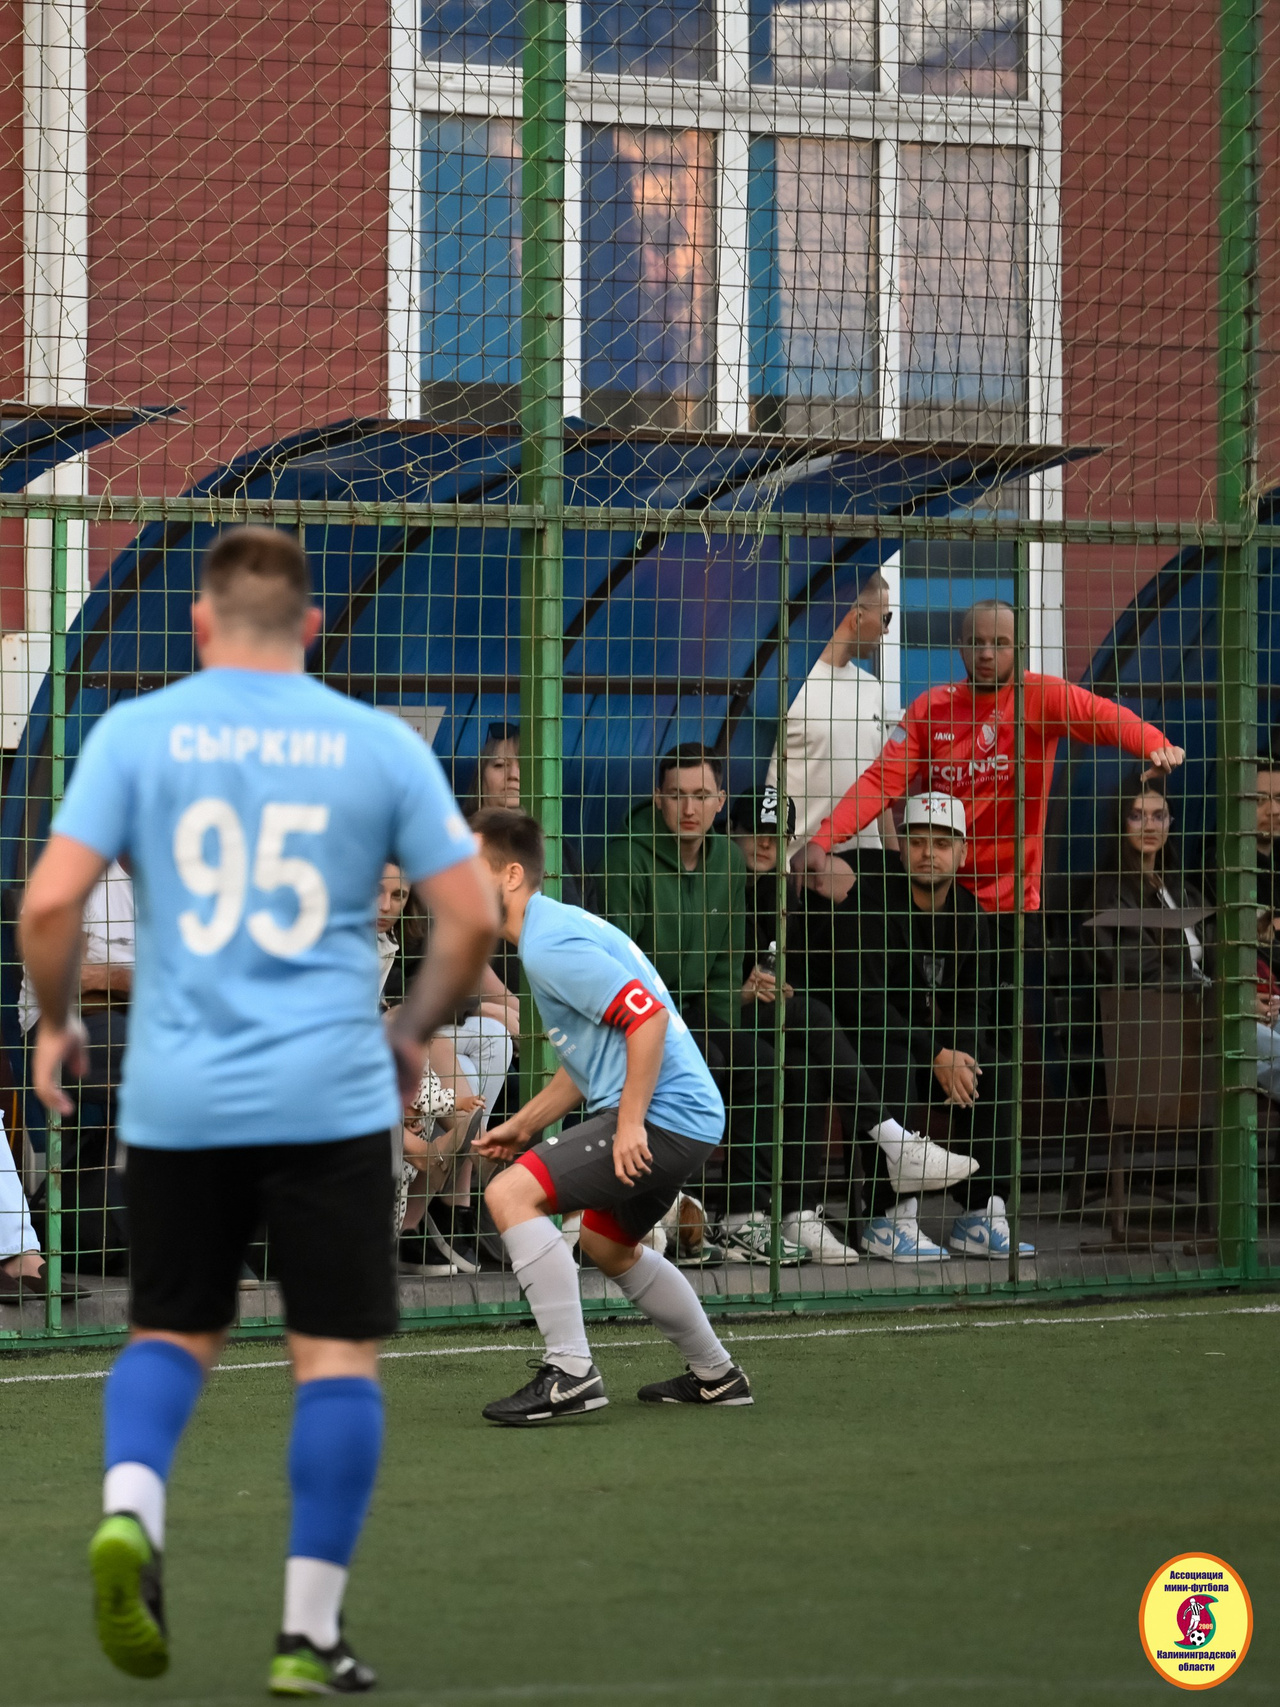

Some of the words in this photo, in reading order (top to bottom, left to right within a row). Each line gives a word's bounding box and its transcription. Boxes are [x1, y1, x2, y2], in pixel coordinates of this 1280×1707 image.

[170, 724, 347, 770] СЫРКИН
[934, 731, 955, 741] JAKO
[173, 798, 330, 958] 95
[624, 987, 654, 1016] C
